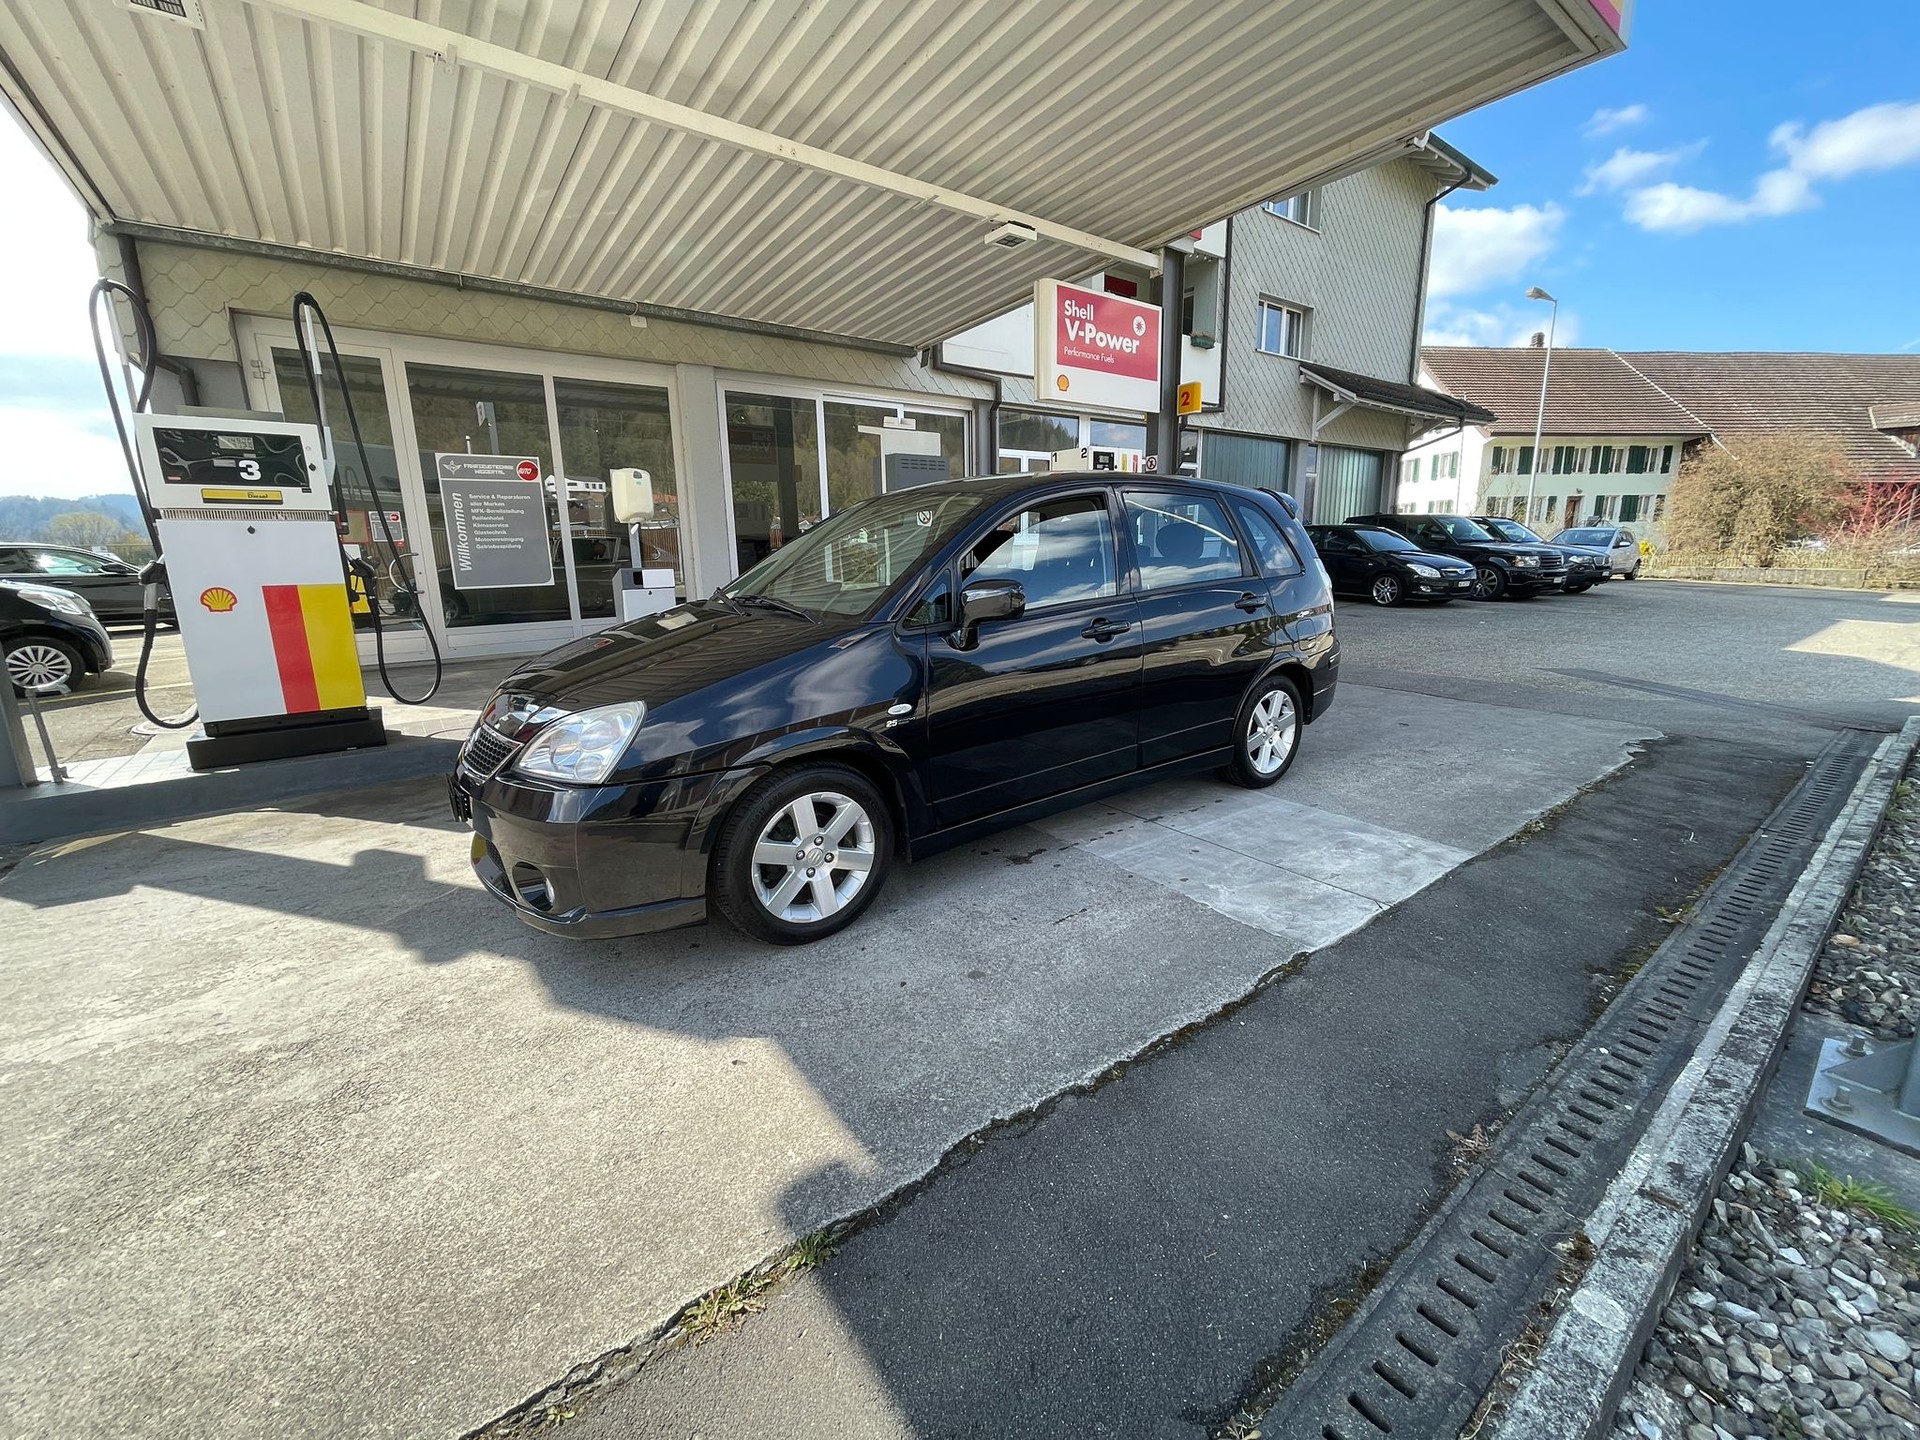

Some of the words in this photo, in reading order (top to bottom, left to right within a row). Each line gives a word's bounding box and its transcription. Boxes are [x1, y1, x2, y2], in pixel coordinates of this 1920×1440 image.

[1064, 300, 1094, 321] Shell
[1064, 318, 1140, 354] V-Power
[1064, 346, 1100, 361] Performance
[1181, 391, 1190, 407] 2
[1052, 452, 1058, 463] 1
[1081, 447, 1088, 459] 2
[238, 459, 262, 481] 3
[452, 492, 473, 571] Willkommen
[885, 719, 898, 728] 25
